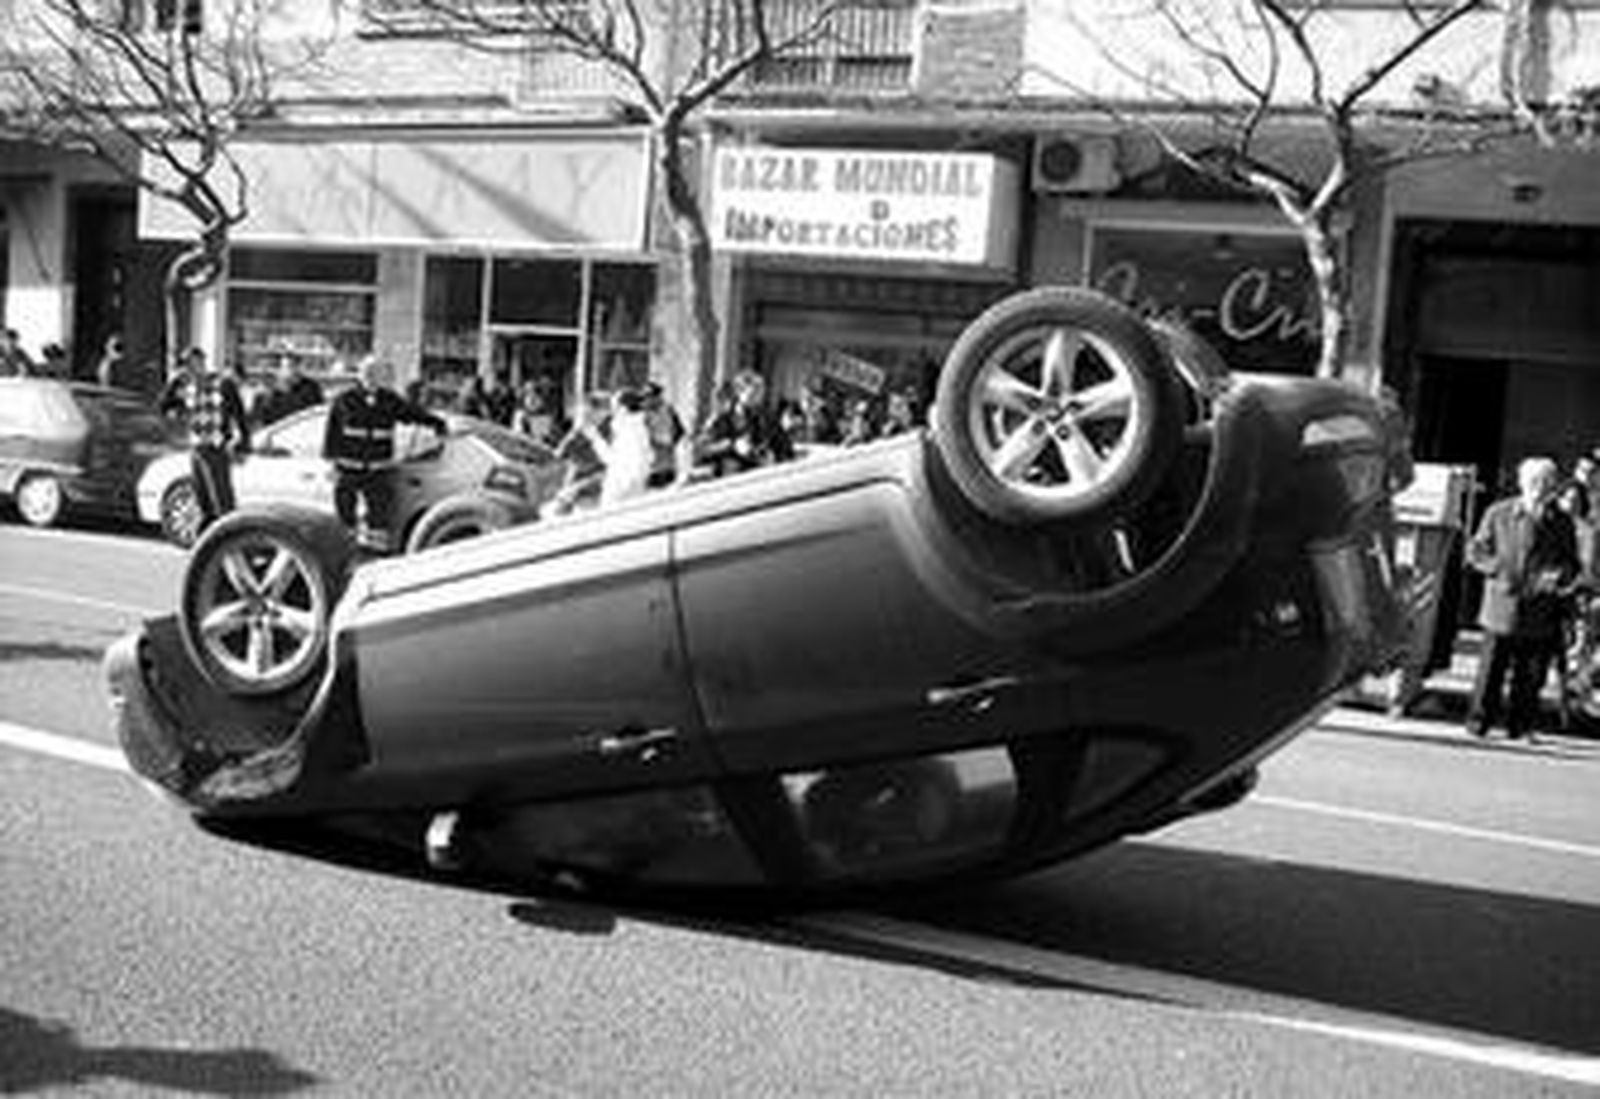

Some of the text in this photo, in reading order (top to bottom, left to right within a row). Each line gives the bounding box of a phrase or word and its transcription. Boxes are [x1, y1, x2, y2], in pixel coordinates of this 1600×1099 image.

[721, 157, 983, 197] BAZAR MUNDIAL
[724, 205, 959, 252] IMPORTACIONES
